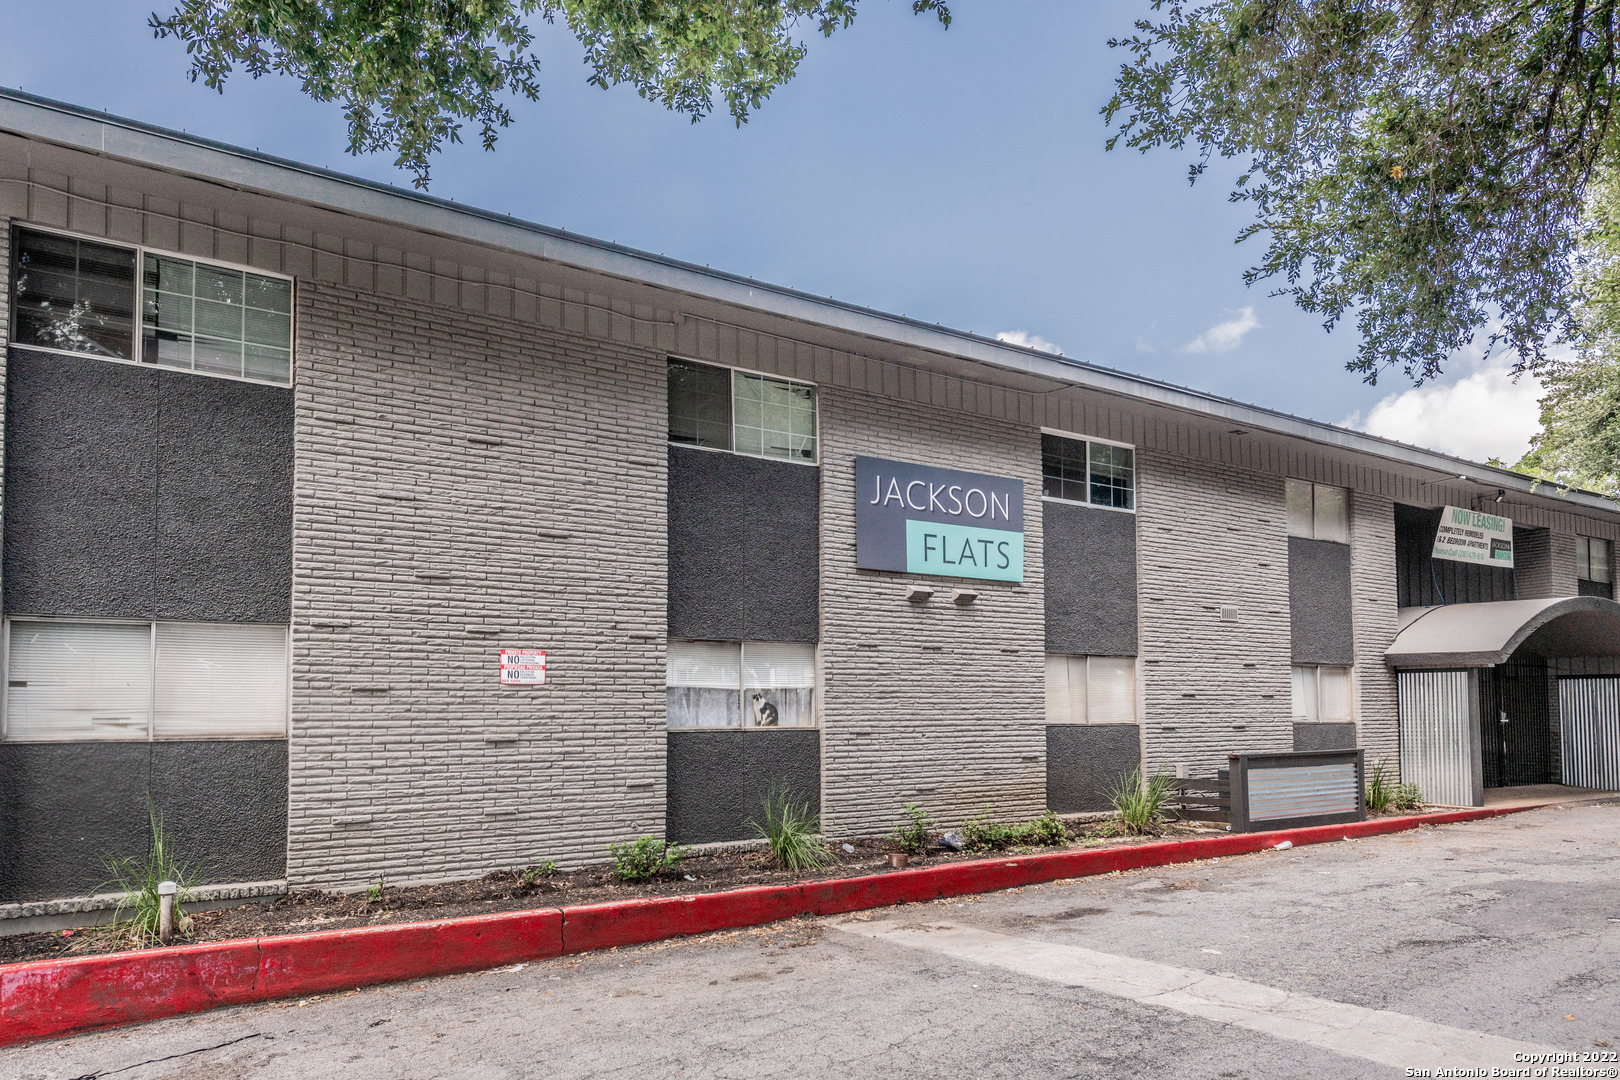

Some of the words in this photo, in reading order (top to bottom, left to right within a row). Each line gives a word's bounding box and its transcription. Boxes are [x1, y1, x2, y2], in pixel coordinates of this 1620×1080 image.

[870, 475, 1009, 521] JACKSON
[1451, 508, 1471, 526] NOW
[1472, 512, 1506, 532] LEASING!
[1439, 525, 1465, 536] COMPLETELY
[1446, 537, 1467, 546] BEDROOM
[1466, 540, 1489, 550] APARTMENTS
[1491, 541, 1510, 550] JACKSON
[923, 533, 1010, 570] FLATS
[1448, 548, 1458, 557] Call
[1496, 551, 1510, 559] FLATS
[507, 655, 520, 665] NO
[507, 670, 520, 679] NO
